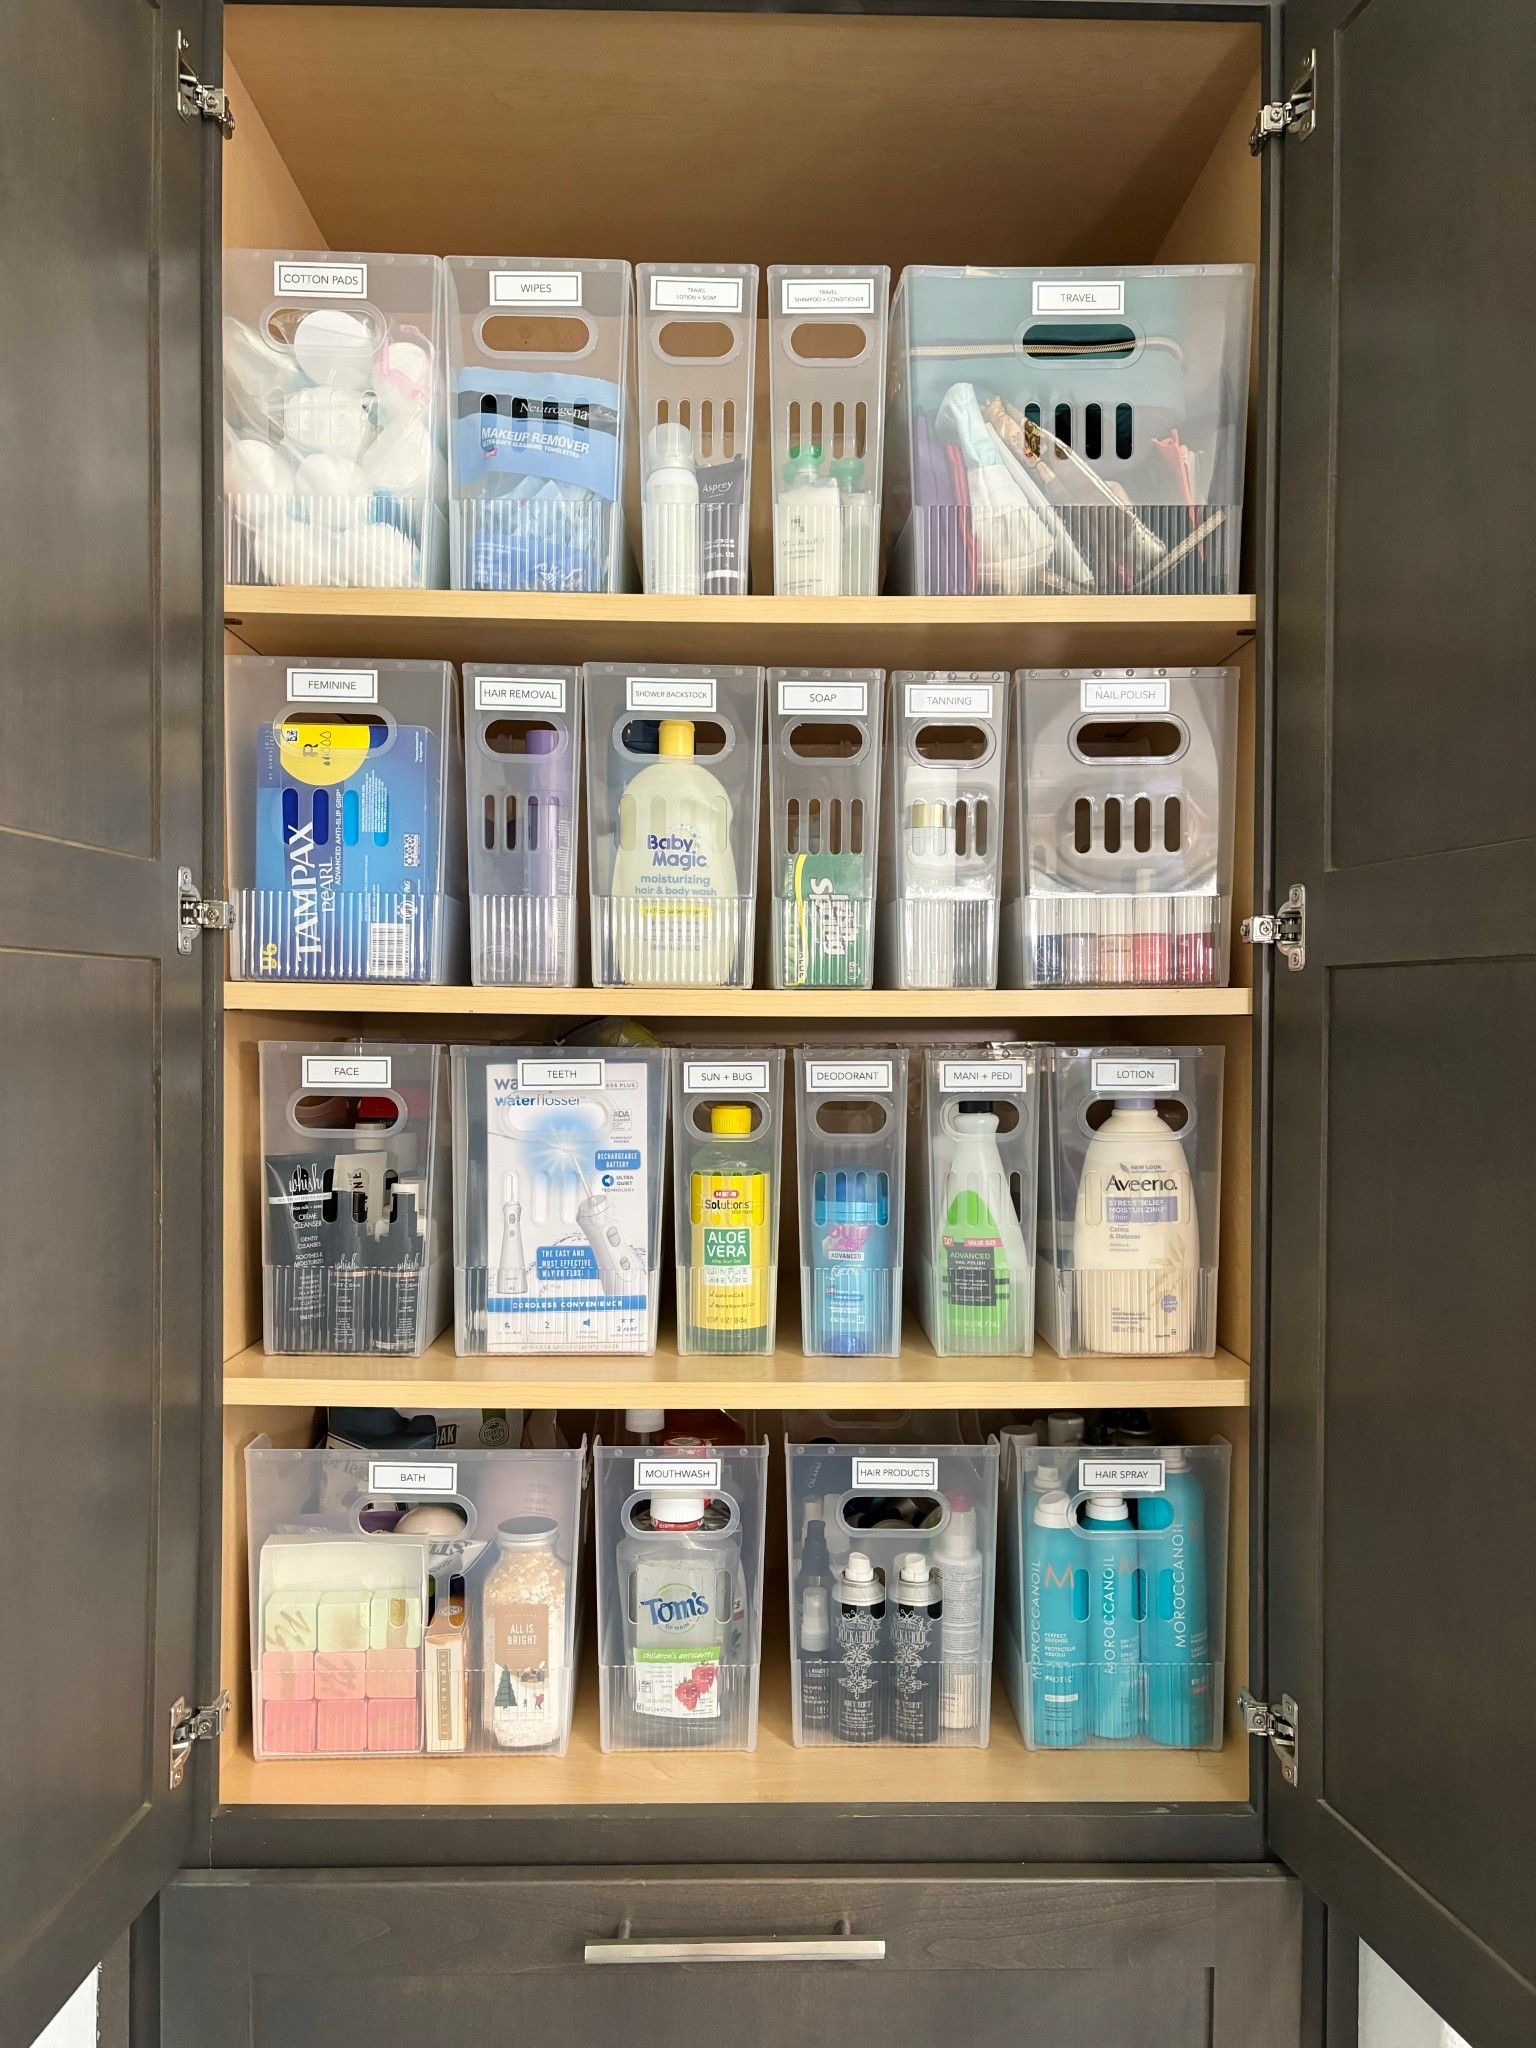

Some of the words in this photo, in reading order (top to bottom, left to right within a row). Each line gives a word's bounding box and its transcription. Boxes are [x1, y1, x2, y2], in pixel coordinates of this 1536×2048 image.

[283, 273, 330, 285] COTTON
[331, 275, 359, 286] PADS
[520, 283, 552, 294] WIPES
[1060, 293, 1096, 303] TRAVEL
[519, 402, 588, 421] Neutrogena
[481, 427, 530, 442] MAKEUP
[531, 433, 590, 454] REMOVER
[702, 481, 734, 494] Asprey
[308, 680, 357, 691] FEMININE
[483, 688, 507, 698] HAIR
[508, 689, 557, 700] REMOVAL
[635, 689, 665, 698] SHOWER
[666, 690, 708, 699] BACKSTOCK
[809, 693, 837, 703] SOAP
[1095, 690, 1119, 699] NAIL
[1120, 690, 1156, 699] POLISH
[926, 696, 972, 706] TANNING
[647, 833, 694, 853] Baby
[334, 845, 342, 885] ADVANCED
[652, 851, 707, 871] Magic
[640, 874, 711, 887] moisturizing
[288, 821, 322, 961] TAMPAX
[635, 886, 655, 895] hair
[656, 887, 663, 895] &
[665, 887, 690, 896] body
[691, 888, 717, 896] wash
[334, 1067, 360, 1076] FACE
[547, 1070, 577, 1079] TEETH
[816, 1071, 879, 1081] DEODORANT
[953, 1071, 979, 1081] MANI
[991, 1071, 1013, 1081] PEDI
[1117, 1070, 1155, 1079] LOTION
[700, 1072, 721, 1082] SUN
[732, 1072, 753, 1082] BUG
[612, 1110, 630, 1118] ADA
[597, 1153, 638, 1161] RECHARGEABLE
[605, 1161, 629, 1169] BATTERY
[293, 1220, 323, 1229] CLEANSER
[300, 1235, 319, 1243] GENTLY
[707, 1231, 746, 1244] ALOE
[297, 1241, 322, 1250] CLEANSES
[541, 1250, 553, 1258] THE
[572, 1249, 585, 1257] AND
[706, 1245, 747, 1258] VERA
[831, 1252, 862, 1260] ADVANCED
[950, 1251, 991, 1260] ADVANCED
[541, 1259, 558, 1267] MOST
[560, 1259, 592, 1267] EFFECTIVE
[560, 1299, 623, 1308] CONVENIENCE
[400, 1473, 426, 1482] BATH
[645, 1470, 710, 1479] MOUTHWASH
[860, 1469, 881, 1477] HAIR
[882, 1469, 930, 1478] PRODUCTS
[1095, 1470, 1117, 1479] HAIR
[1120, 1470, 1149, 1480] SPRAY
[1043, 1563, 1075, 1589] M
[1172, 1523, 1187, 1648] MOROCCANOIL
[640, 1592, 709, 1626] Tom's
[1103, 1555, 1116, 1674] MOROCCANOIL
[1031, 1560, 1041, 1680] MOROCCANOIL
[510, 1623, 524, 1634] ALL
[526, 1623, 534, 1634] IS
[507, 1635, 538, 1646] BRIGHT
[642, 1652, 677, 1660] children's
[678, 1651, 715, 1659] anticavity
